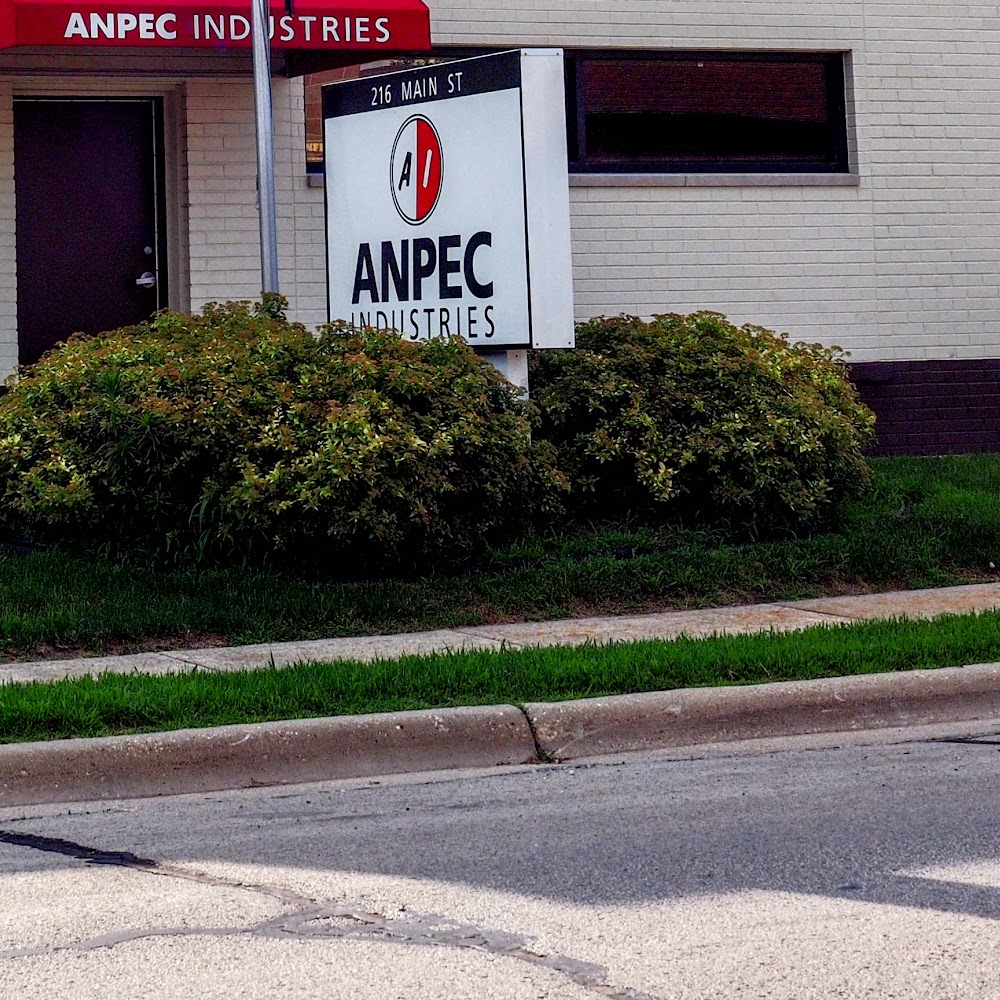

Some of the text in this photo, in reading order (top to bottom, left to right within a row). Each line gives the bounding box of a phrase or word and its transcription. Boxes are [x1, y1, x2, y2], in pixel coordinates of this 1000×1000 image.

[63, 12, 391, 43] ANPEC INDSTRIES
[371, 71, 463, 107] 216 MAIN ST
[351, 231, 494, 305] ANPEC
